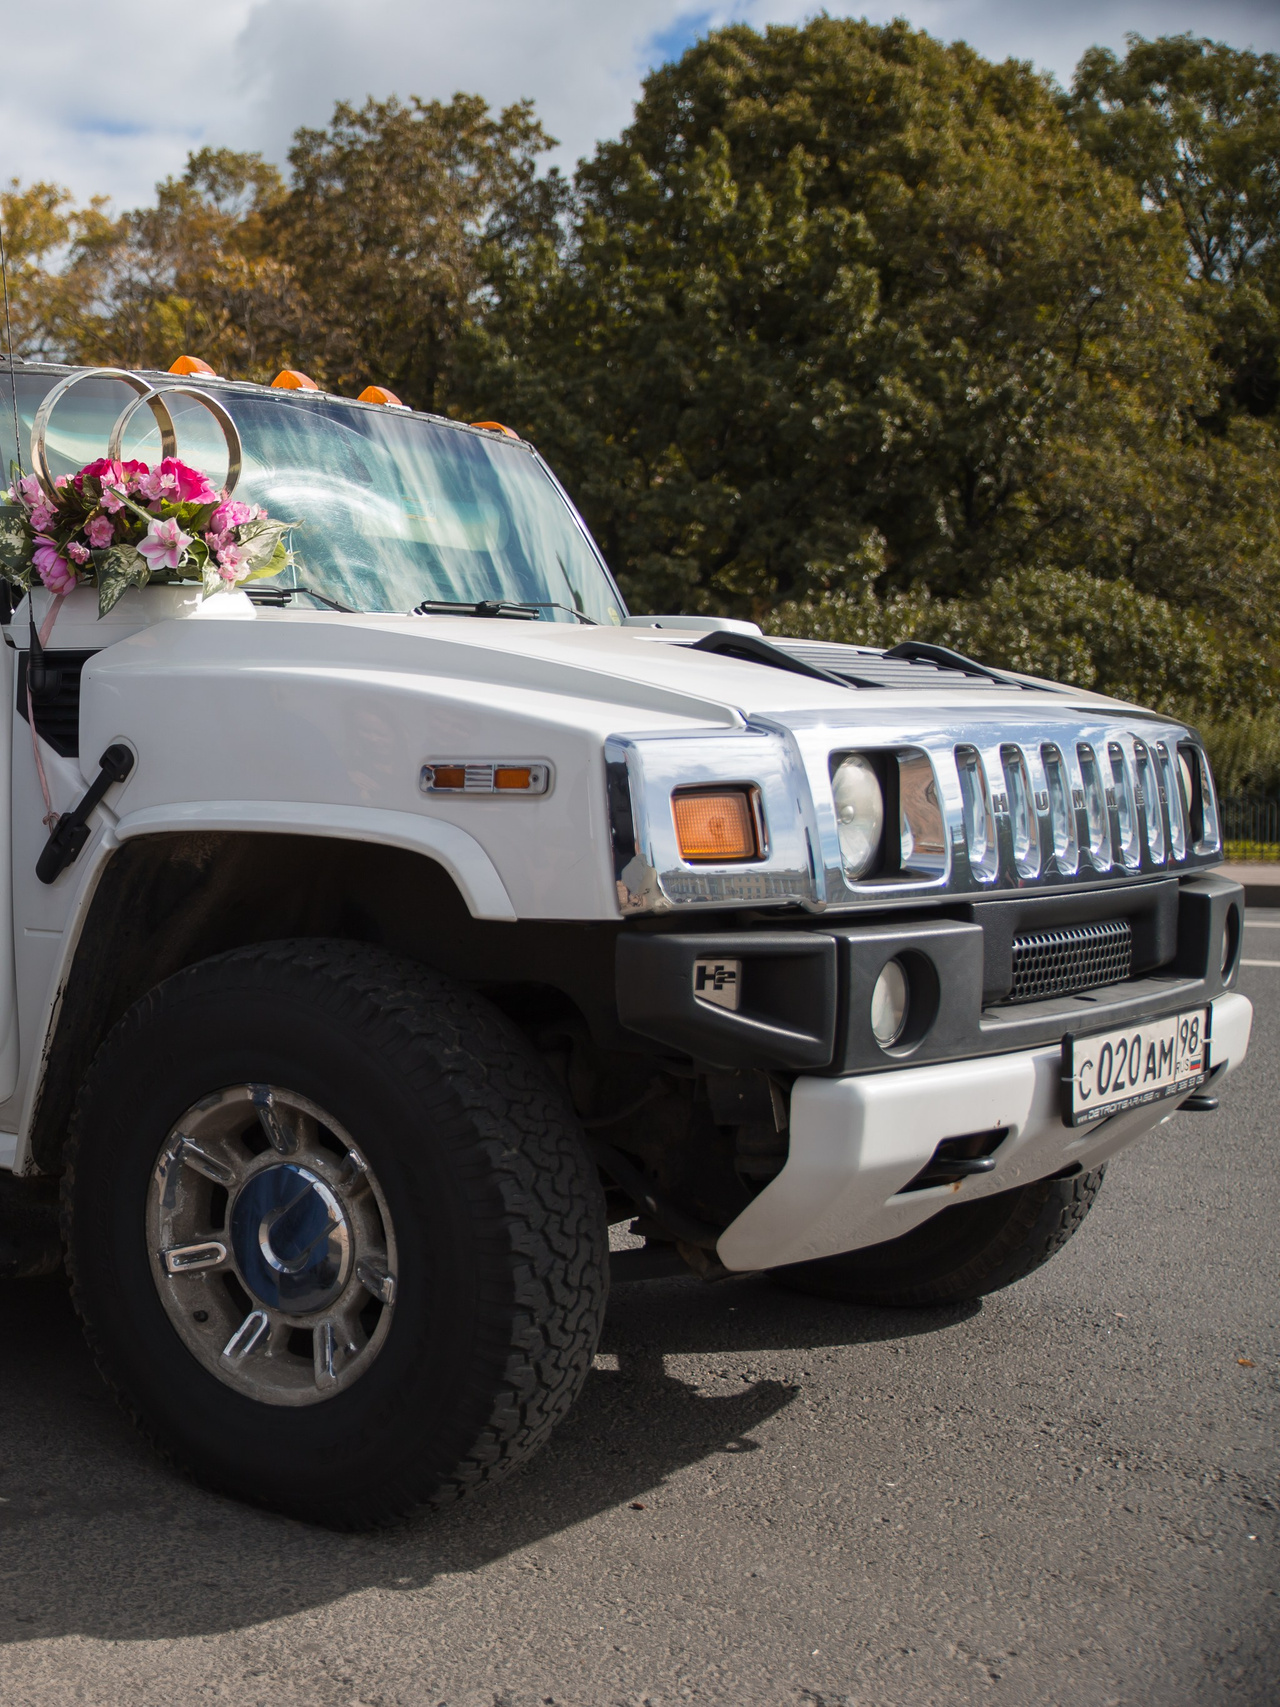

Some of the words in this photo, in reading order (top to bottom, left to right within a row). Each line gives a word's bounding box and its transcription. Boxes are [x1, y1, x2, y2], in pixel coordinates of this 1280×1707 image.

[991, 784, 1169, 814] HUMMER
[695, 965, 736, 990] H2
[1180, 1016, 1200, 1058] 98
[1176, 1057, 1190, 1075] RUS
